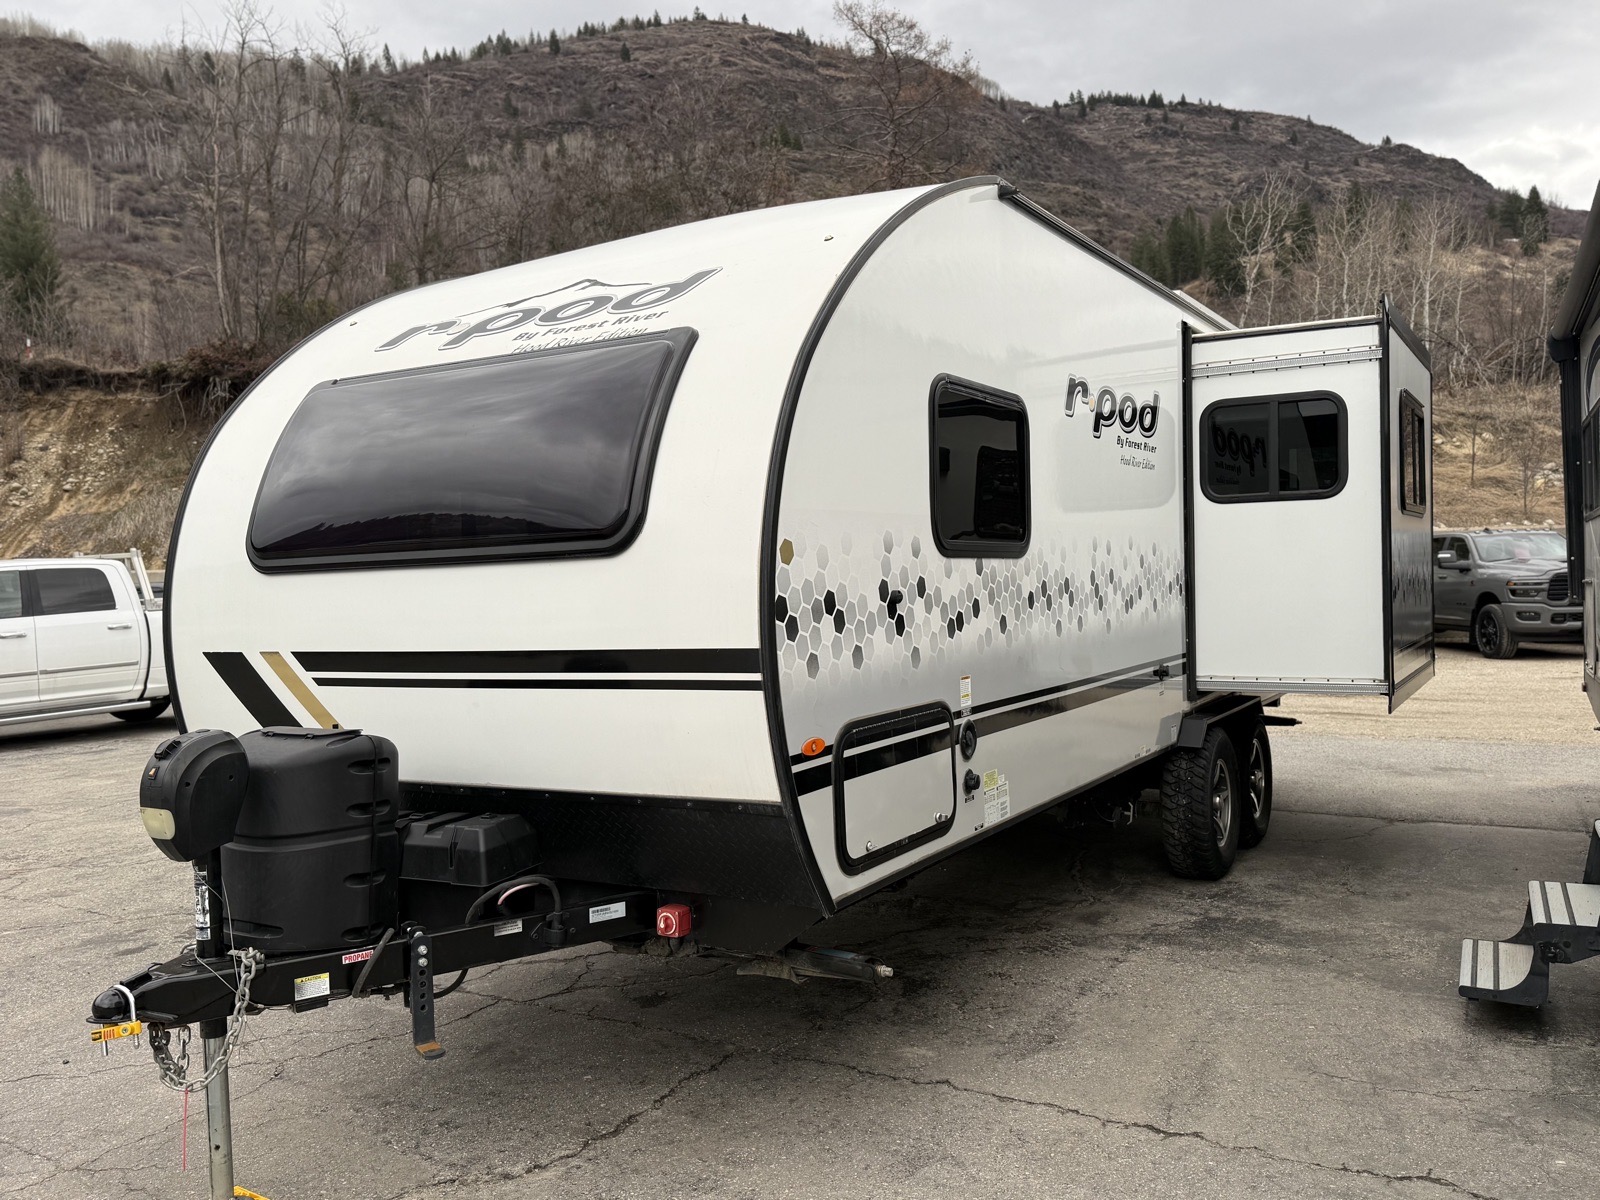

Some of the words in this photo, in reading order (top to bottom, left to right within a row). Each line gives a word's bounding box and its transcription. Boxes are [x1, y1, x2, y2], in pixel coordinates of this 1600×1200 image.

[512, 332, 540, 342] By
[541, 320, 610, 337] Forest
[611, 311, 669, 326] River
[551, 336, 593, 348] River
[593, 327, 649, 342] Edition
[1116, 435, 1124, 448] By
[1125, 437, 1142, 450] Forest
[1143, 441, 1156, 453] River
